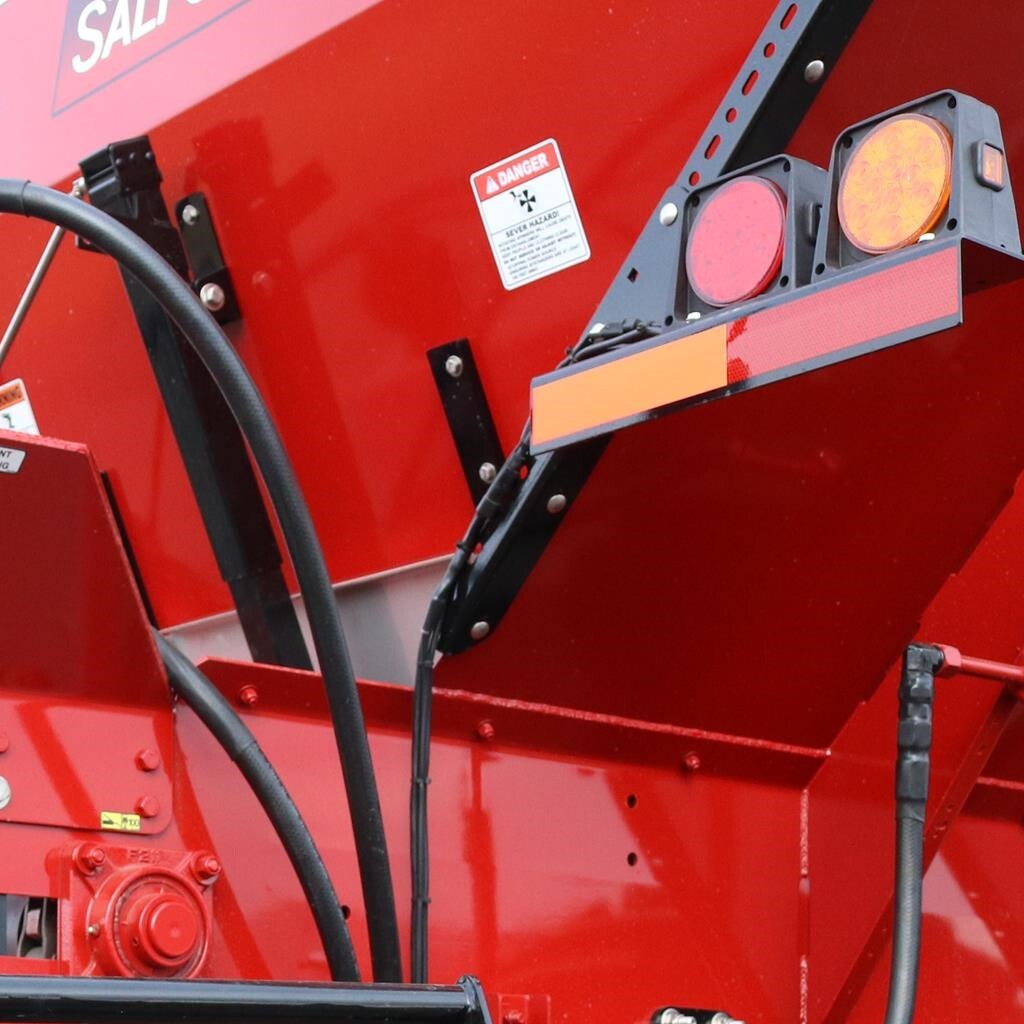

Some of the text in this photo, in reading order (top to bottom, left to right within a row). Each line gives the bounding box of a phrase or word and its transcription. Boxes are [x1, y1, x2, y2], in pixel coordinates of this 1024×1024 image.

[72, 0, 203, 73] SAL
[498, 152, 549, 186] DANGER
[506, 223, 528, 238] SEVER
